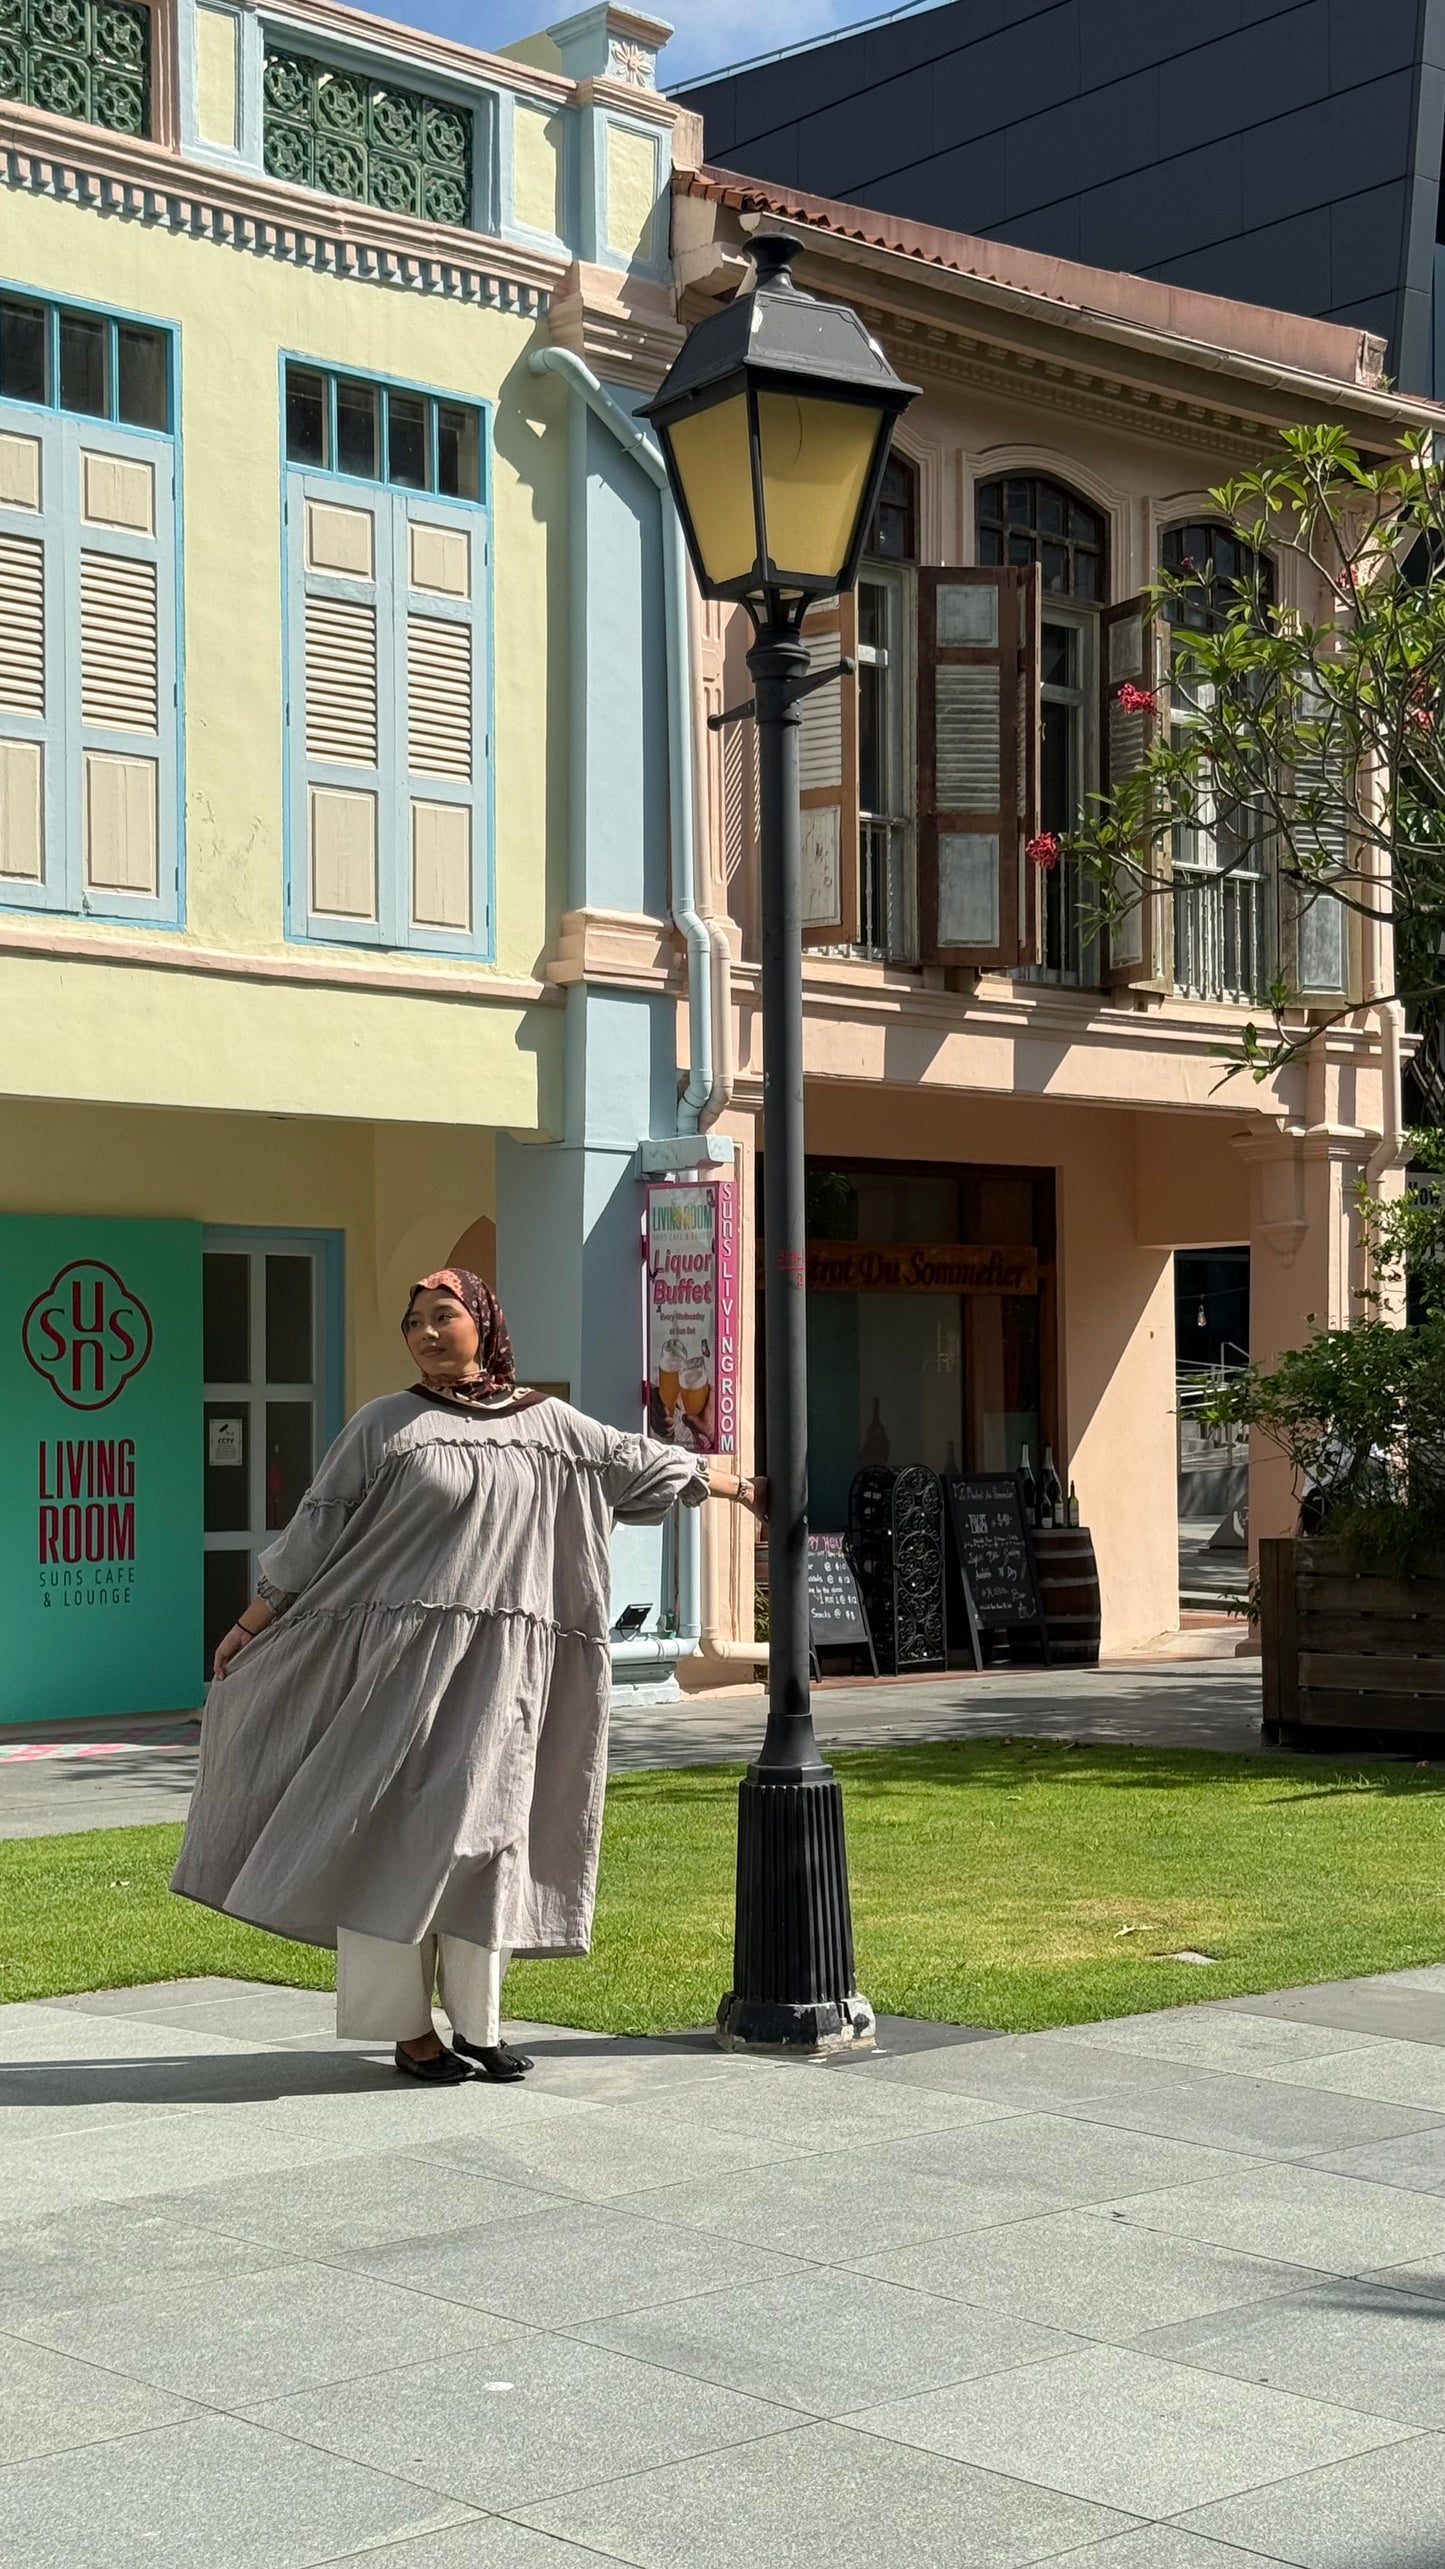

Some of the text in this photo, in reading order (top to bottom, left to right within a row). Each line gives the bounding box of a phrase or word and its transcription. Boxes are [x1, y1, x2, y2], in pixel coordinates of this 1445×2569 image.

[653, 1204, 713, 1231] LIVING ROOM
[653, 1249, 713, 1280] Liquor
[859, 1250, 901, 1286] Du
[905, 1252, 1028, 1288] Sommelier
[653, 1279, 713, 1305] Buffet
[721, 1261, 735, 1372] LIVING
[720, 1378, 735, 1452] ROOM
[38, 1438, 136, 1500] LIVING
[38, 1502, 136, 1565] ROOM
[95, 1567, 136, 1585] CAFE
[43, 1593, 52, 1608] &
